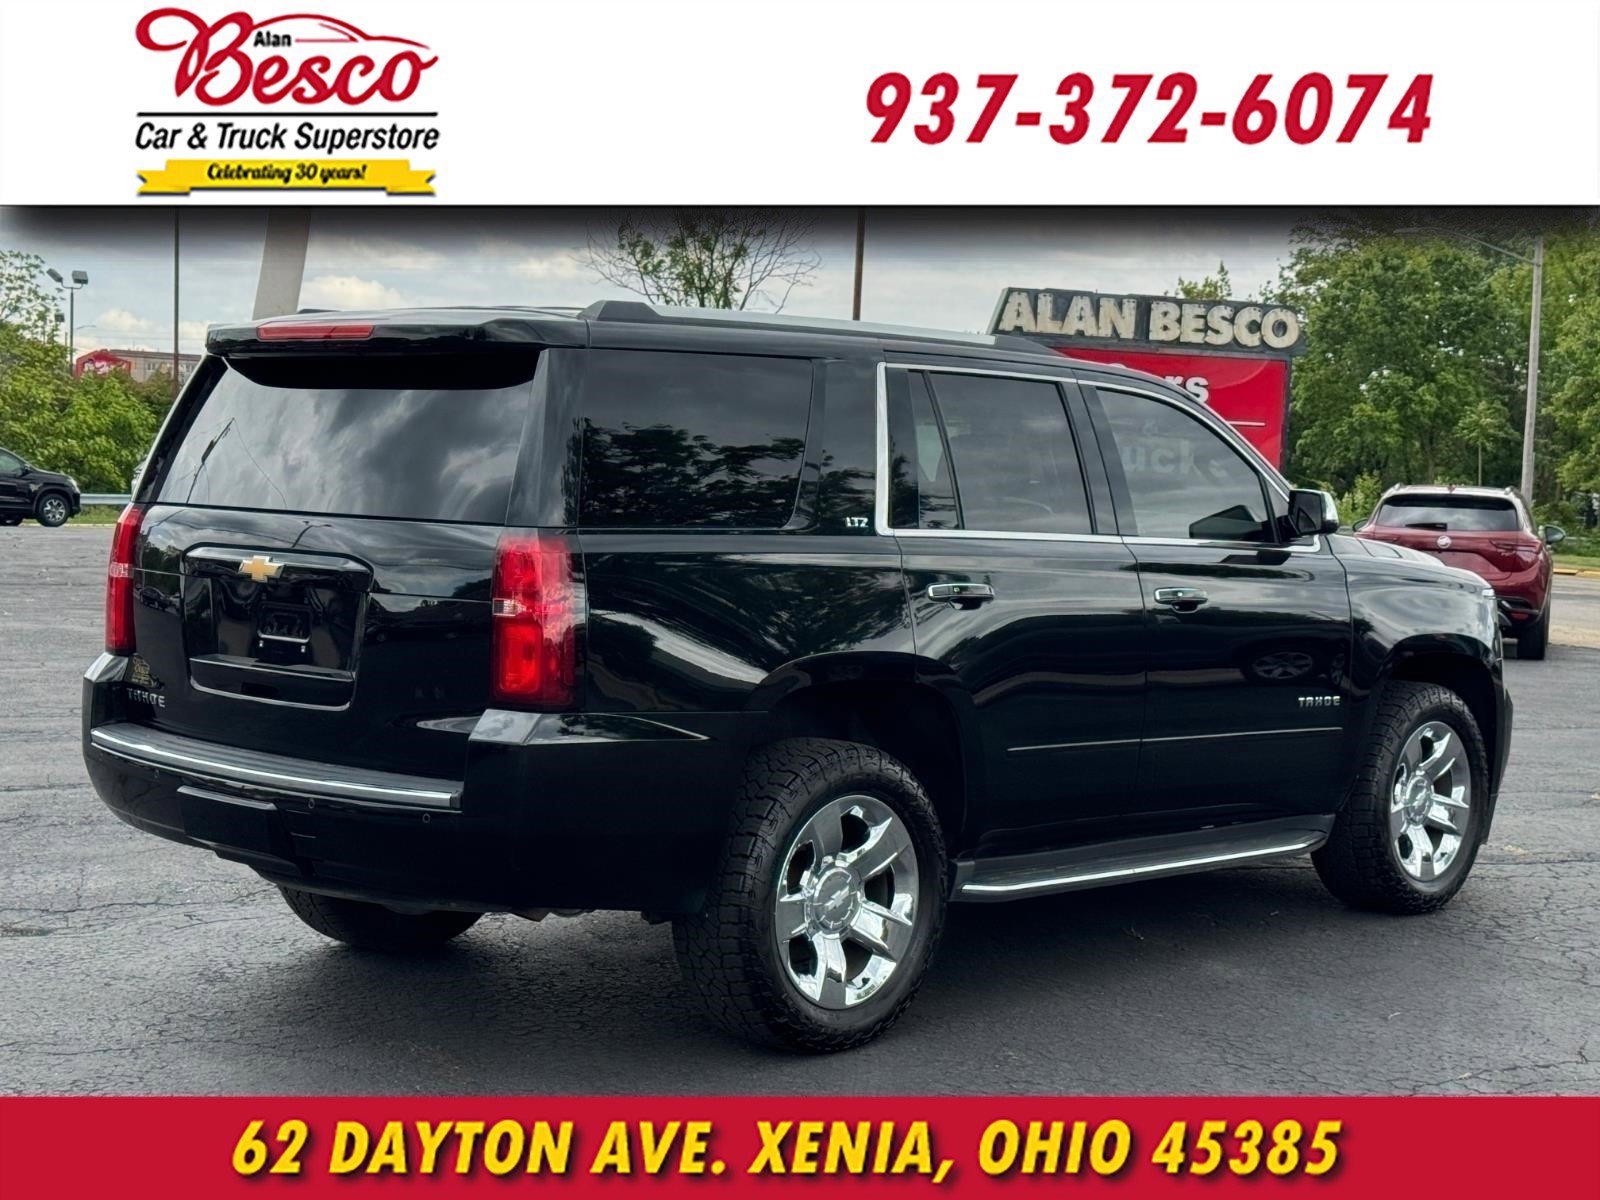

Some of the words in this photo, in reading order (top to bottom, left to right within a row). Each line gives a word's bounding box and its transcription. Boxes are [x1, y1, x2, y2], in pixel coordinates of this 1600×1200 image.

[998, 291, 1136, 339] ALAN
[1149, 300, 1301, 349] BESCO
[844, 516, 869, 528] LTZ
[126, 687, 166, 708] TAHOE
[1297, 695, 1341, 708] TAHOE
